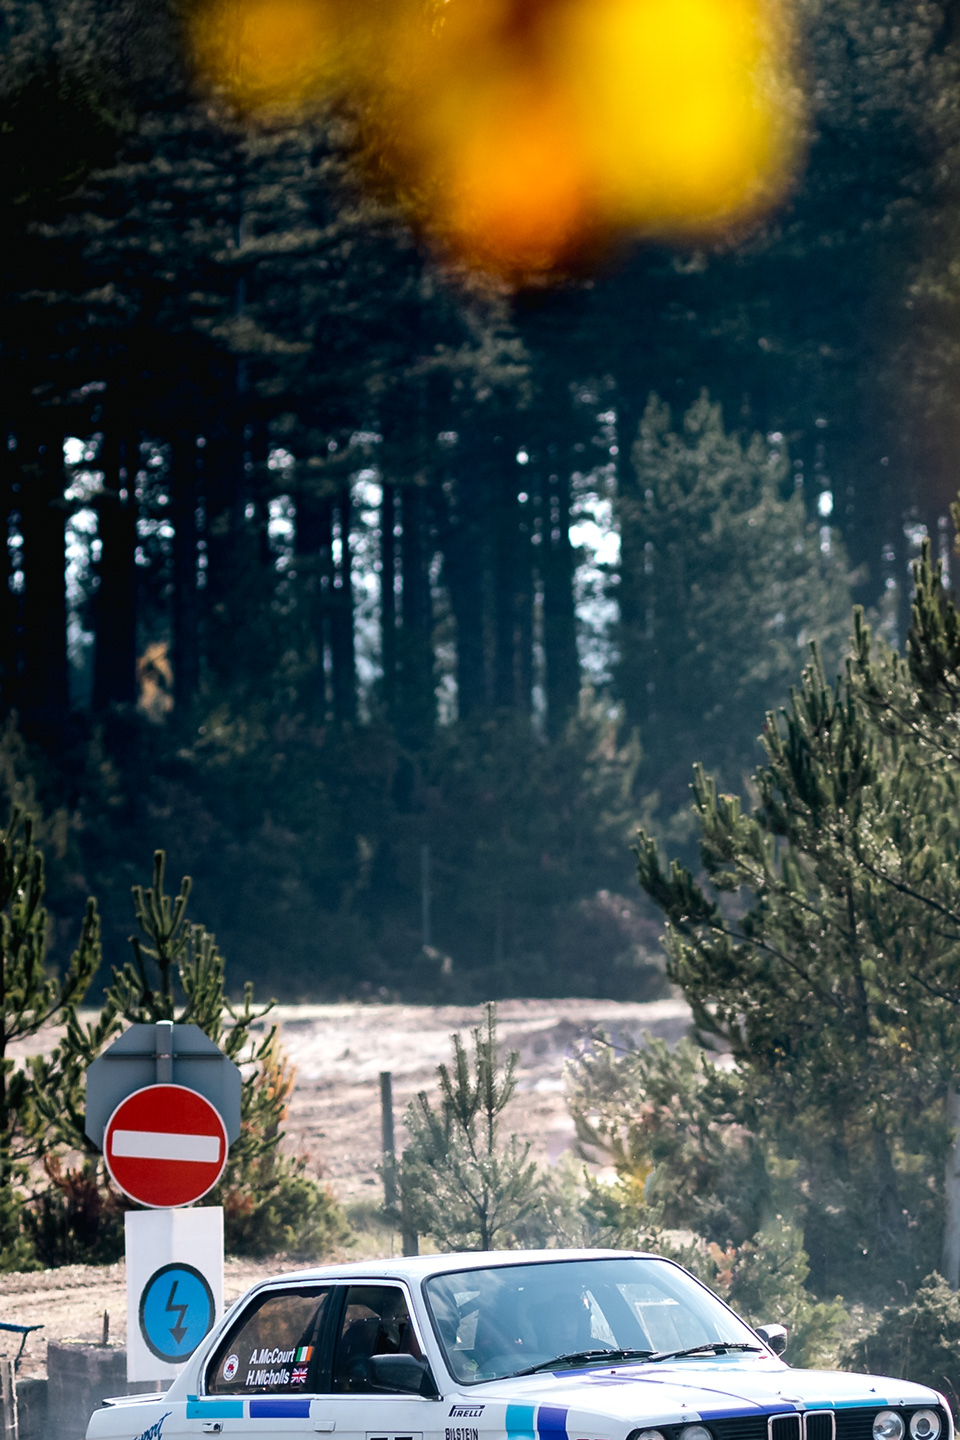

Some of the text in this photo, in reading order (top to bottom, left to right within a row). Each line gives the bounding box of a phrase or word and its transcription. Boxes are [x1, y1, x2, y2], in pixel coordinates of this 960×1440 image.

[249, 1347, 296, 1365] A.McCourt
[245, 1368, 290, 1386] H.Nicholls
[448, 1404, 486, 1417] PIRELLI
[445, 1428, 479, 1440] BILSTEIN
